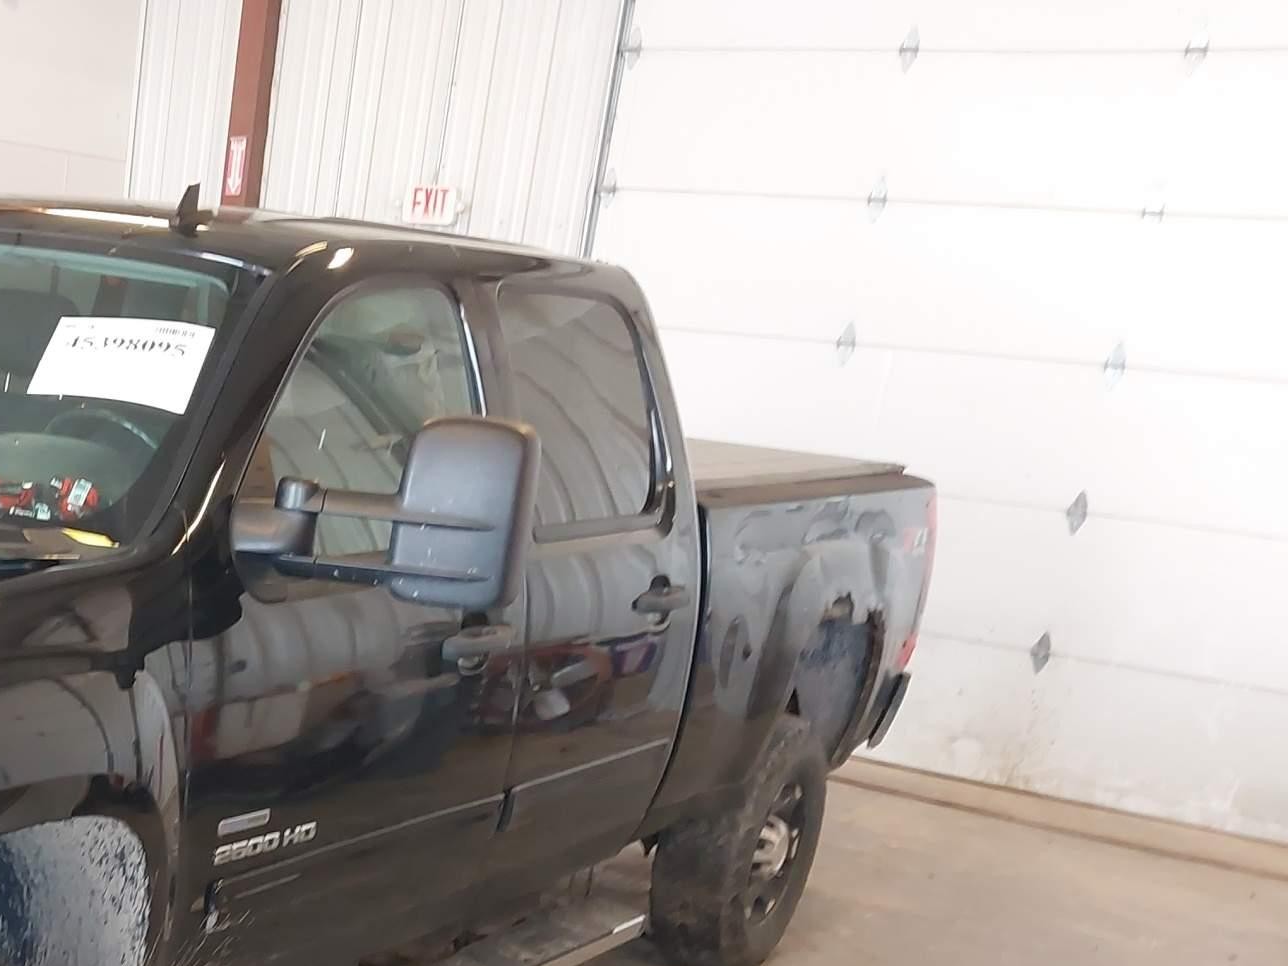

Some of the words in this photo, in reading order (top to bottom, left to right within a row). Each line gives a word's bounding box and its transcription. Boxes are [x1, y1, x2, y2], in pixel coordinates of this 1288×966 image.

[412, 187, 449, 217] EXIT
[213, 831, 281, 866] 2500
[282, 821, 318, 848] HD
